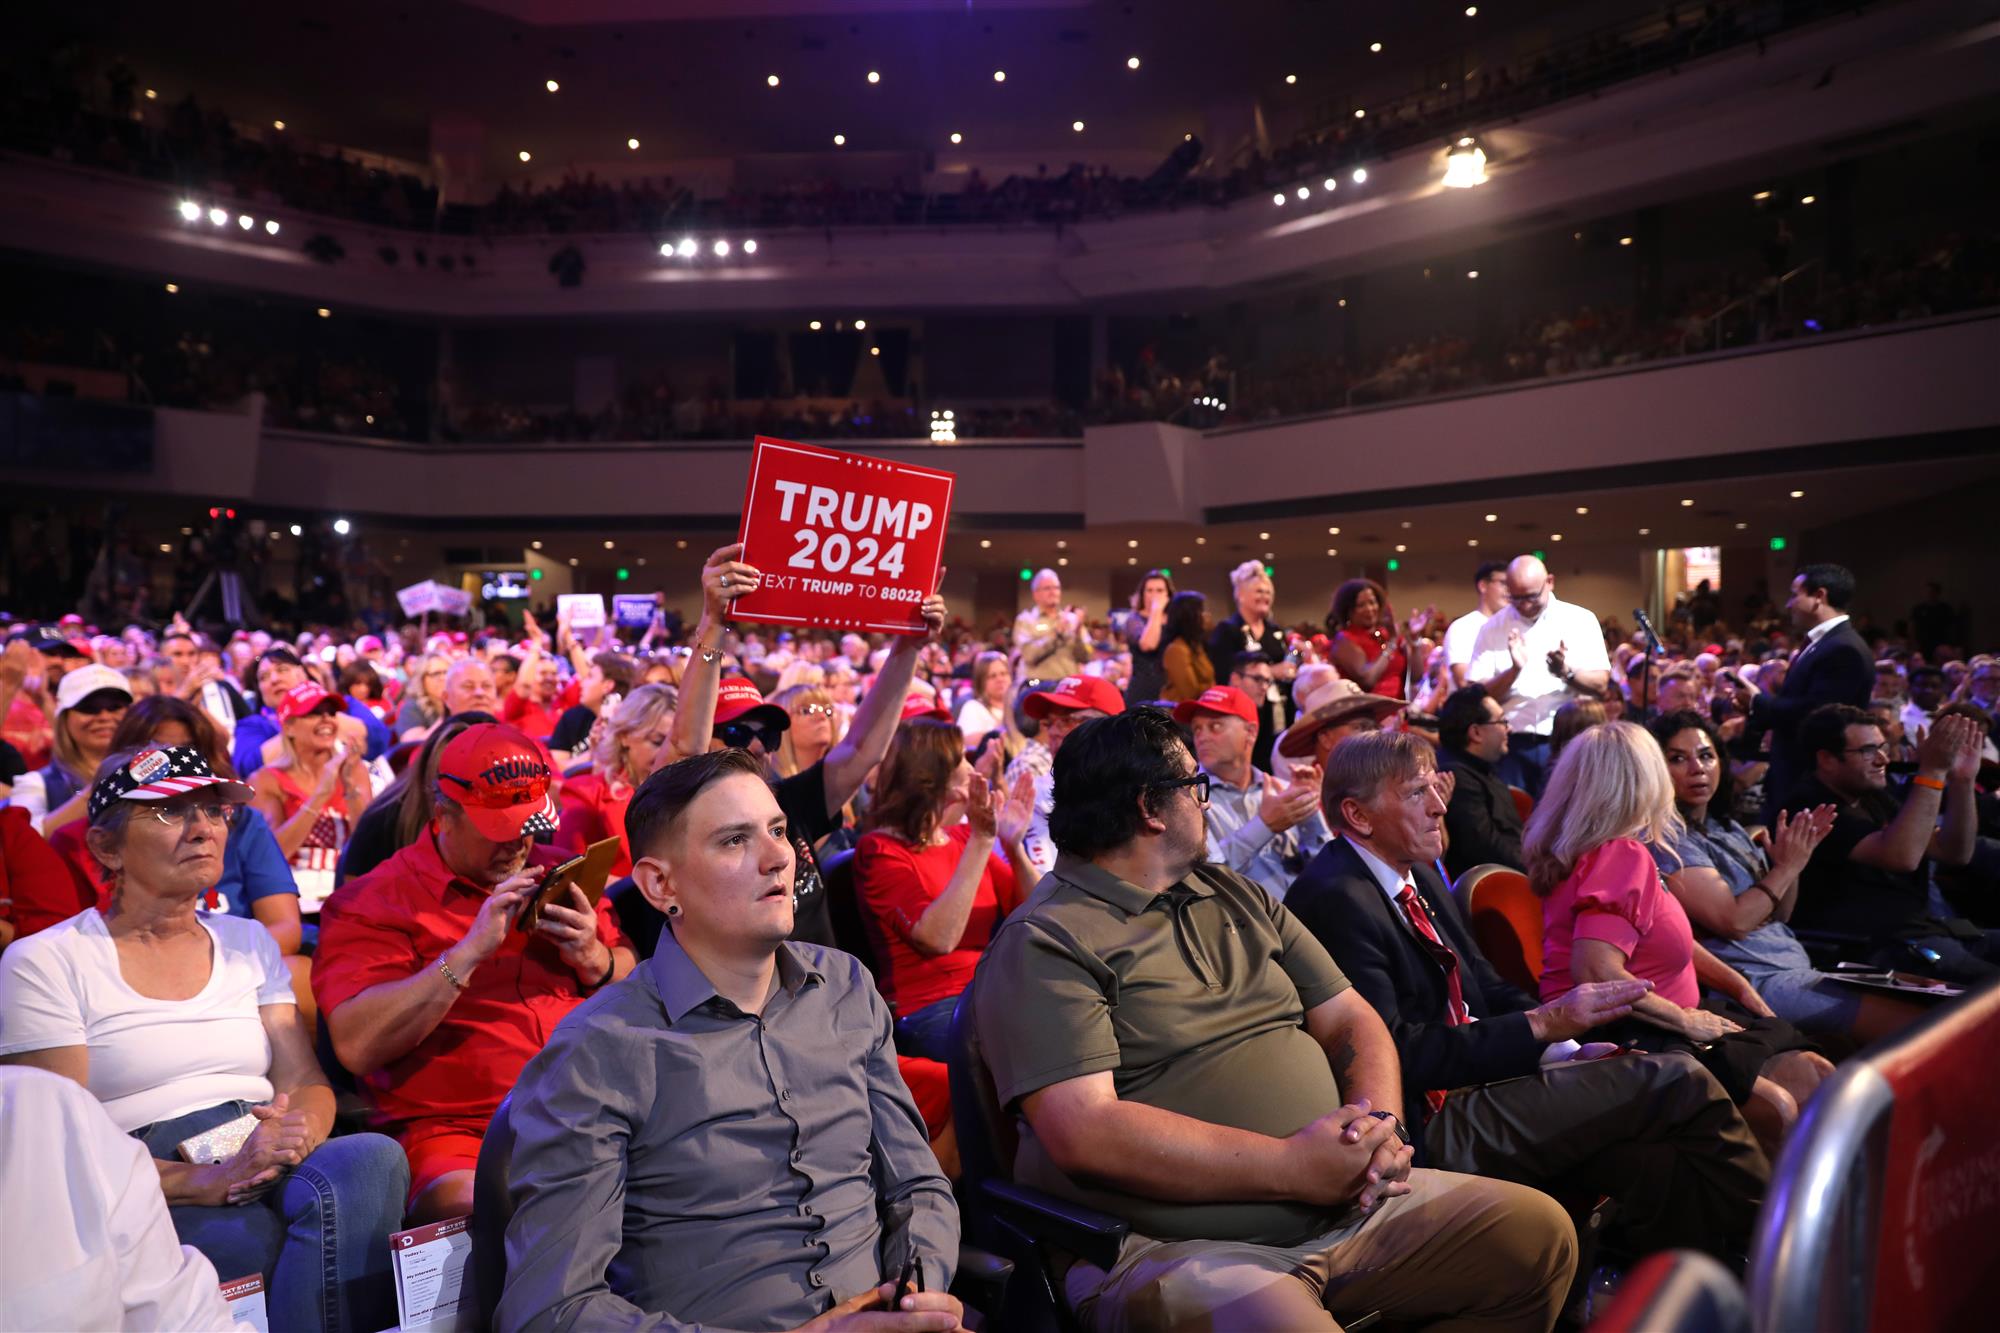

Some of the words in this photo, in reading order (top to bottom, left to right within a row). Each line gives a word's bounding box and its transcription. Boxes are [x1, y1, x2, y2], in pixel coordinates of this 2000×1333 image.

[775, 480, 933, 539] TRUMP
[788, 529, 906, 579] 2024
[757, 573, 796, 589] TEXT
[802, 578, 854, 596] TRUMP
[859, 584, 877, 598] TO
[881, 587, 922, 603] 88022
[138, 757, 163, 777] TRUMP
[479, 761, 540, 784] TRUMP
[222, 1287, 236, 1295] EXT
